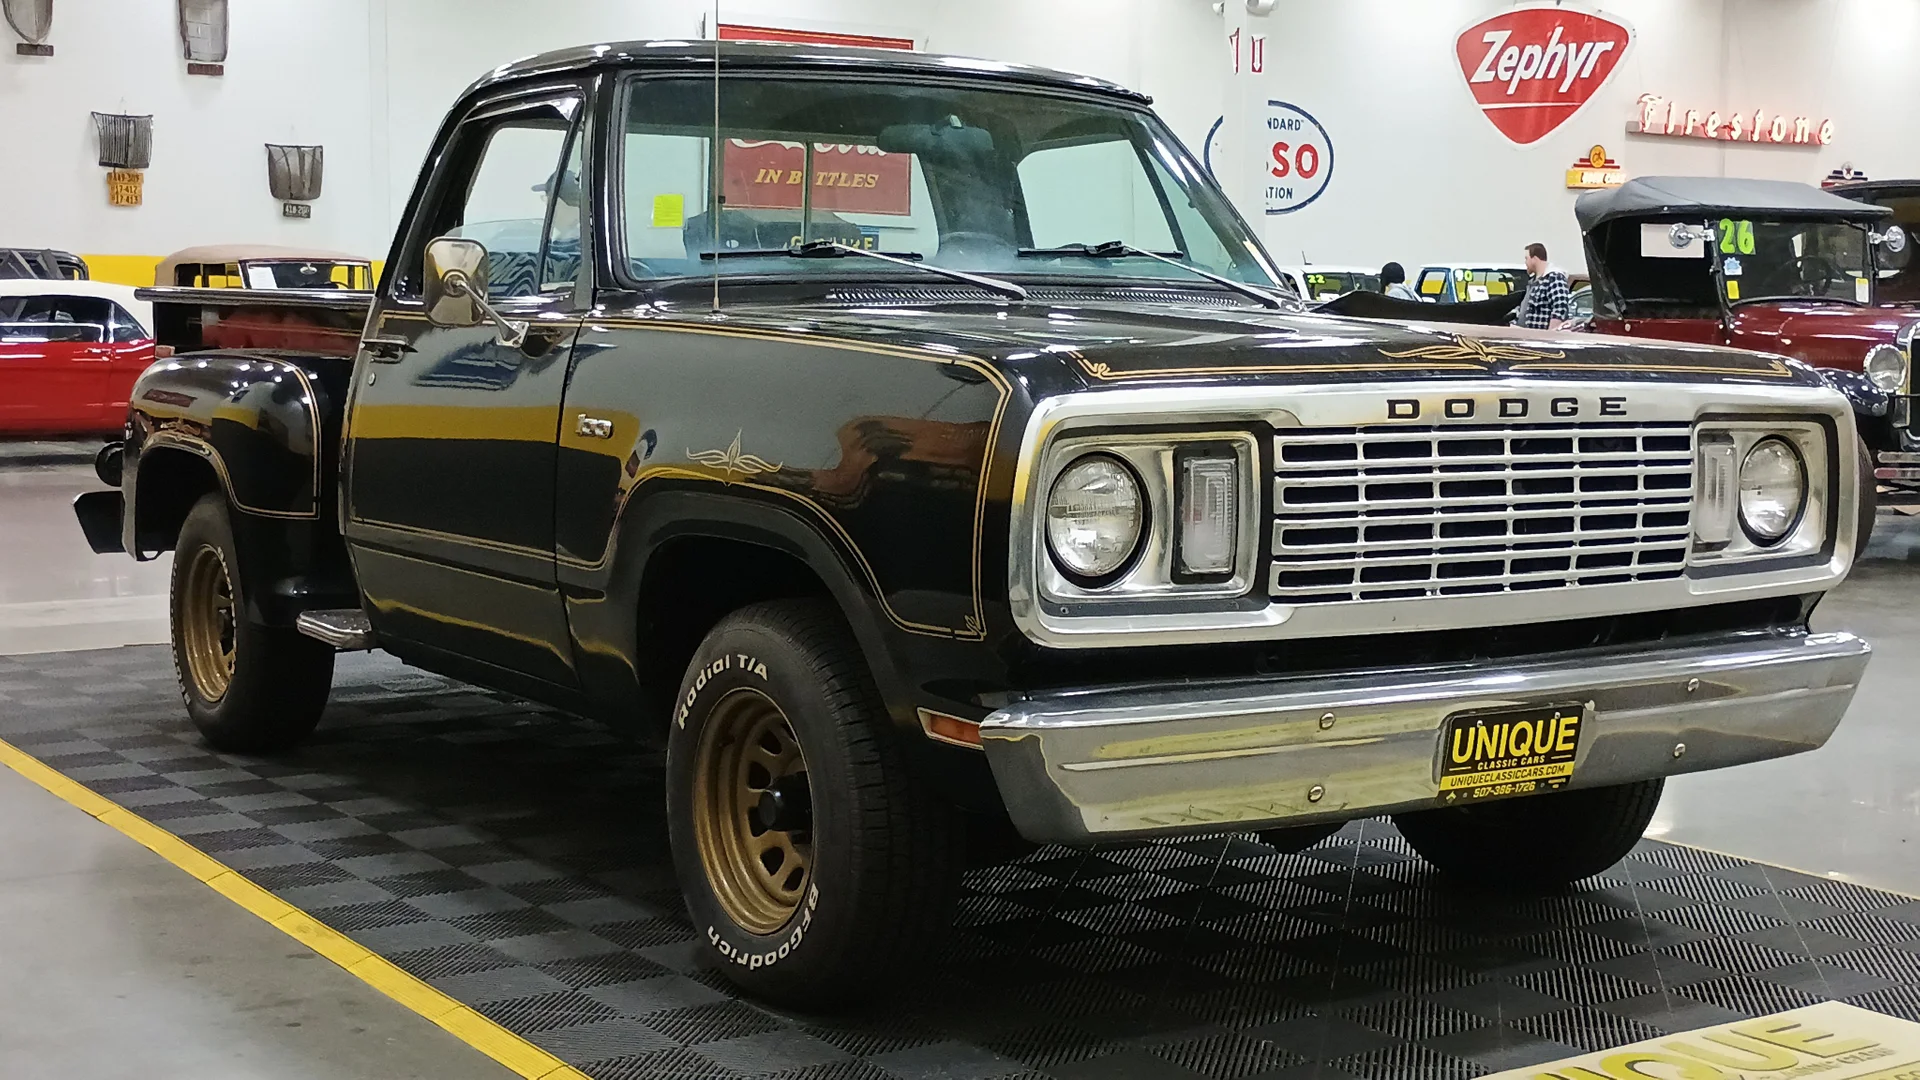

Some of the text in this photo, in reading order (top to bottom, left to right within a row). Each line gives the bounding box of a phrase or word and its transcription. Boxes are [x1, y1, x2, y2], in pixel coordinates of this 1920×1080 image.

[1469, 26, 1615, 95] Zephyr
[1267, 118, 1301, 131] NDARD
[1637, 93, 1835, 145] Firestone
[1270, 141, 1319, 179] SO
[755, 168, 879, 188] IN BTTLES
[1266, 187, 1293, 200] TION
[1719, 218, 1755, 254] 26
[1307, 274, 1327, 285] 22
[1386, 396, 1627, 419] DODGE
[677, 654, 769, 730] Radial T/A
[1451, 716, 1578, 764] UNIQUE
[1477, 755, 1545, 771] CLASSIC CARS
[1450, 764, 1566, 787] UNIQUECLASSICCARS.COM
[1473, 781, 1536, 798] 507-386-1726
[707, 882, 821, 972] BFGoodrich
